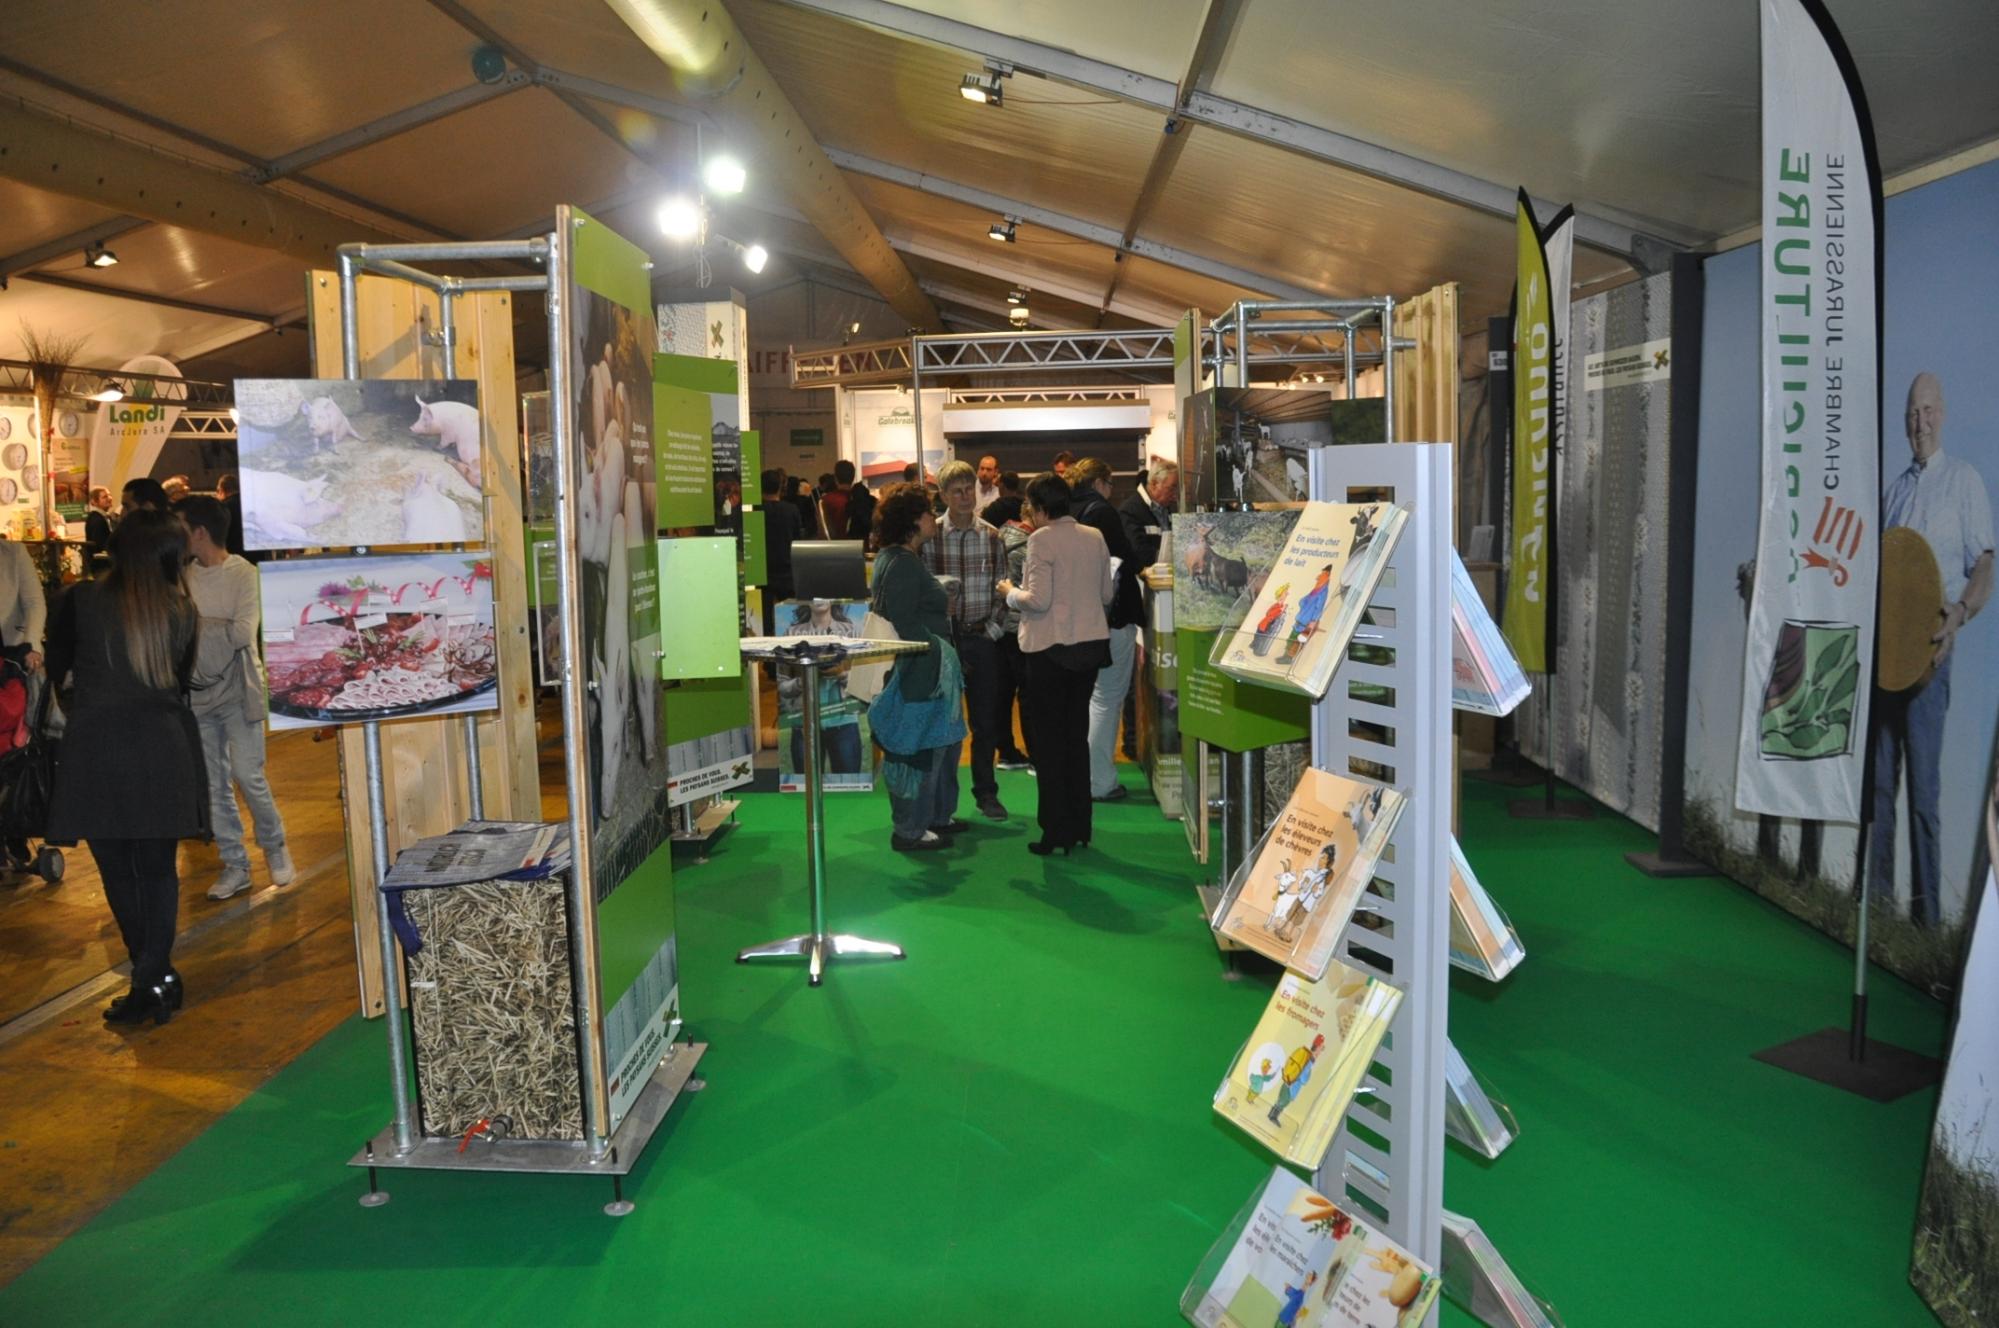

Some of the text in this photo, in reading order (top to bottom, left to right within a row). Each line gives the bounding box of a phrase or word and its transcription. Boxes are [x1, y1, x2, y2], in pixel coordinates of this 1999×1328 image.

[110, 404, 165, 423] Landi
[153, 426, 165, 434] SA
[1296, 534, 1341, 546] En visite chez
[1290, 546, 1339, 558] les producteurs
[1284, 557, 1307, 567] de lait
[680, 786, 689, 794] LES
[1286, 814, 1334, 838] En visite chez
[1281, 824, 1322, 847] les éleveurs
[1275, 835, 1313, 857] de chèvres
[1276, 1001, 1286, 1013] les
[1281, 990, 1326, 1018] En visite chez
[1258, 1212, 1268, 1224] En
[1252, 1224, 1262, 1236] les
[1245, 1236, 1255, 1248] de
[1269, 1244, 1278, 1254] les
[1274, 1234, 1282, 1244] En
[1282, 1241, 1297, 1255] visite
[1296, 1252, 1309, 1265] chez
